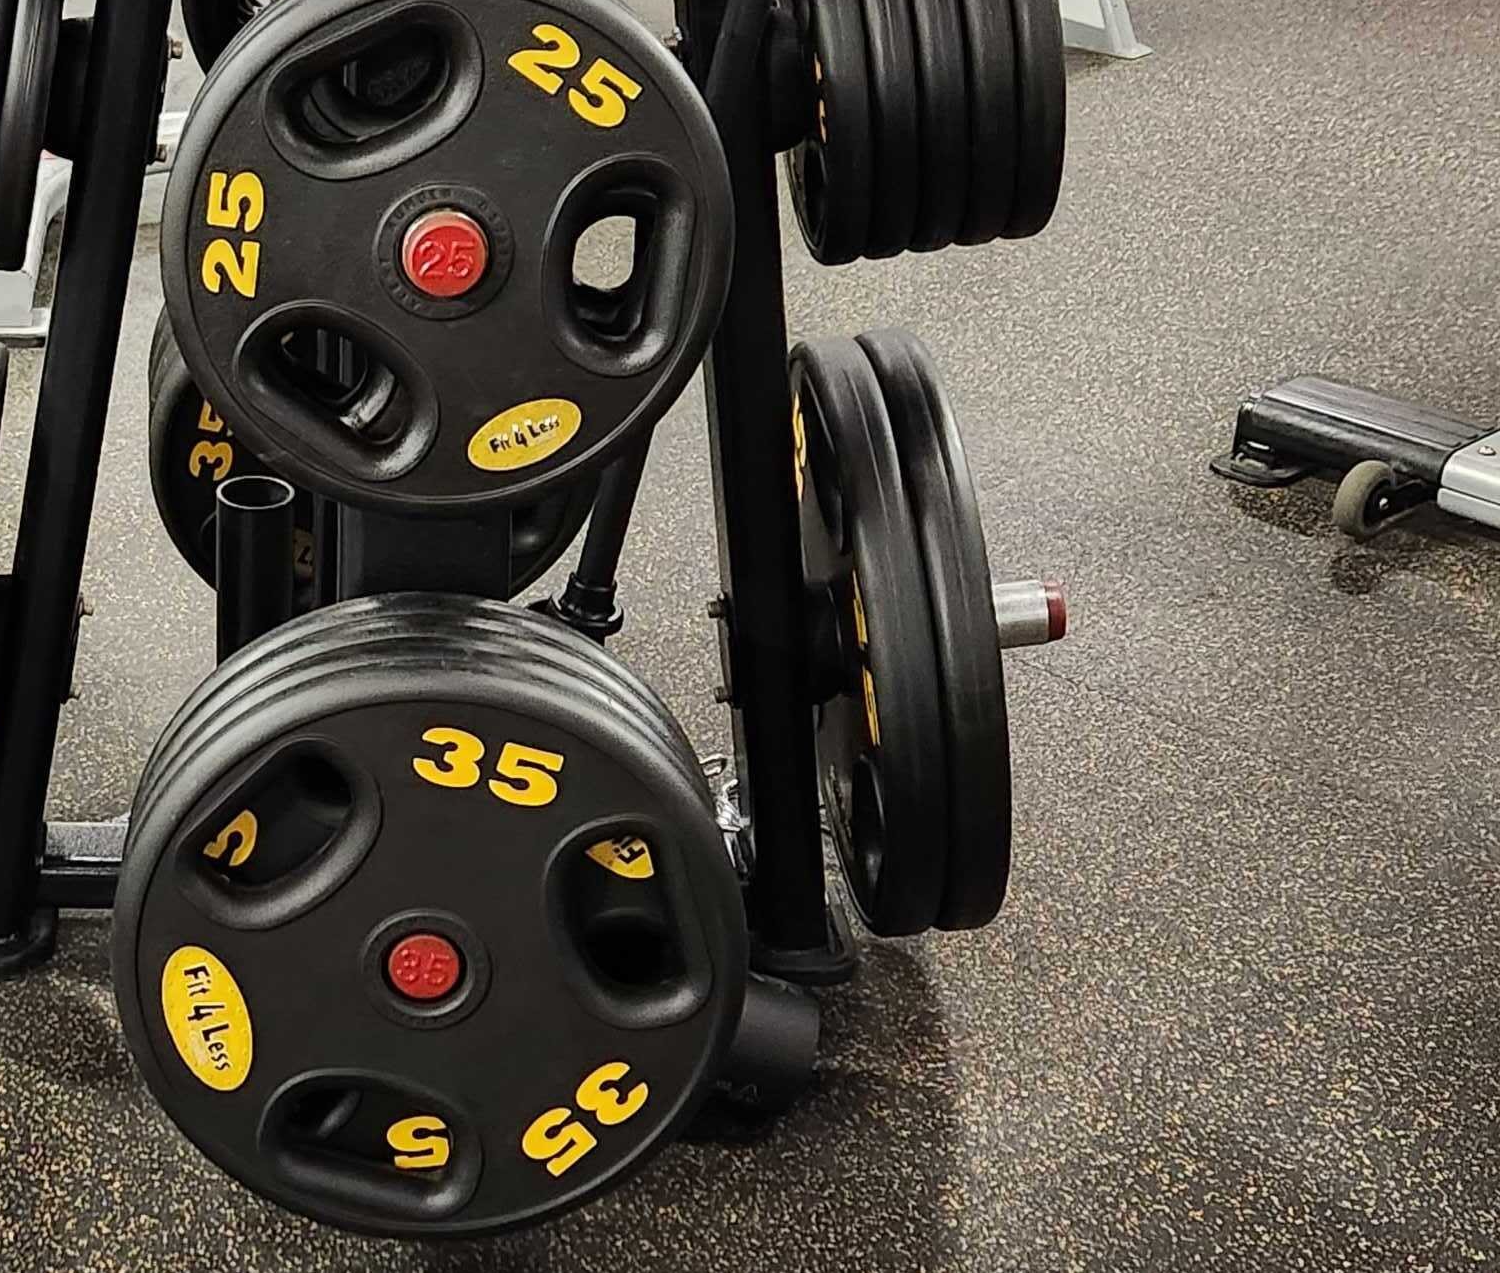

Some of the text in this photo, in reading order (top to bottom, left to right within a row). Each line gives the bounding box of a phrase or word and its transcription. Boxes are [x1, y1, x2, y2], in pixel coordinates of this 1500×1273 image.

[507, 23, 642, 128] 25
[201, 171, 265, 298] 25
[418, 239, 475, 278] 25
[489, 419, 560, 453] Fit 4 Less
[412, 726, 564, 807] 35
[396, 949, 450, 984] 35
[184, 965, 230, 1070] Fit 4 Less
[521, 1061, 649, 1177] 35
